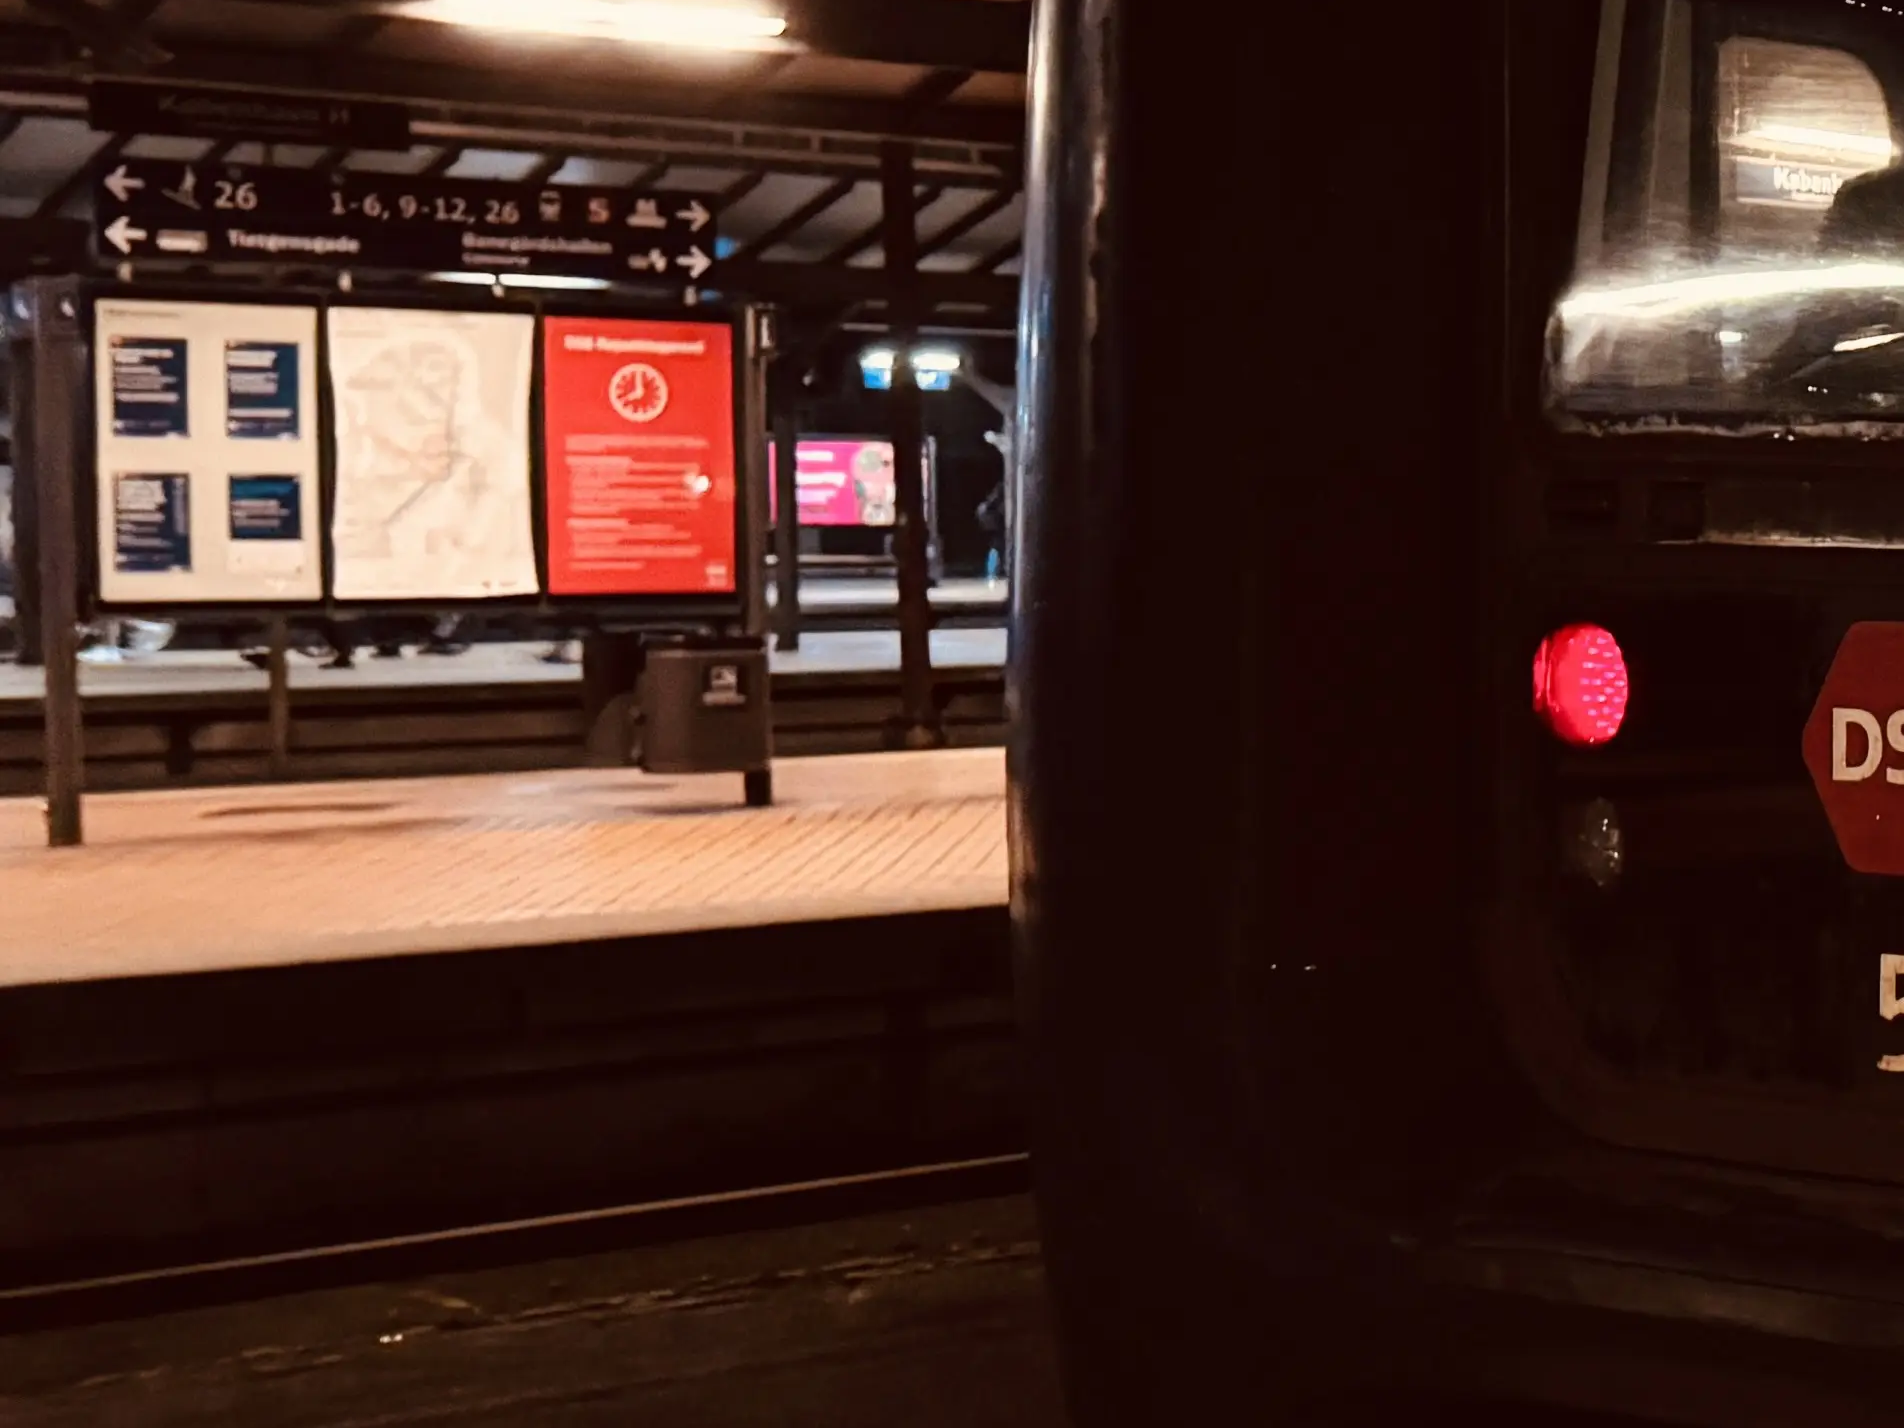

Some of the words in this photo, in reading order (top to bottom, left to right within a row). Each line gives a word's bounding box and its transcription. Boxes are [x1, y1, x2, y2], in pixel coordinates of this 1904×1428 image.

[214, 180, 258, 211] 26
[331, 192, 390, 221] 1-6,
[399, 195, 475, 224] 9-12,
[485, 200, 520, 224] 26
